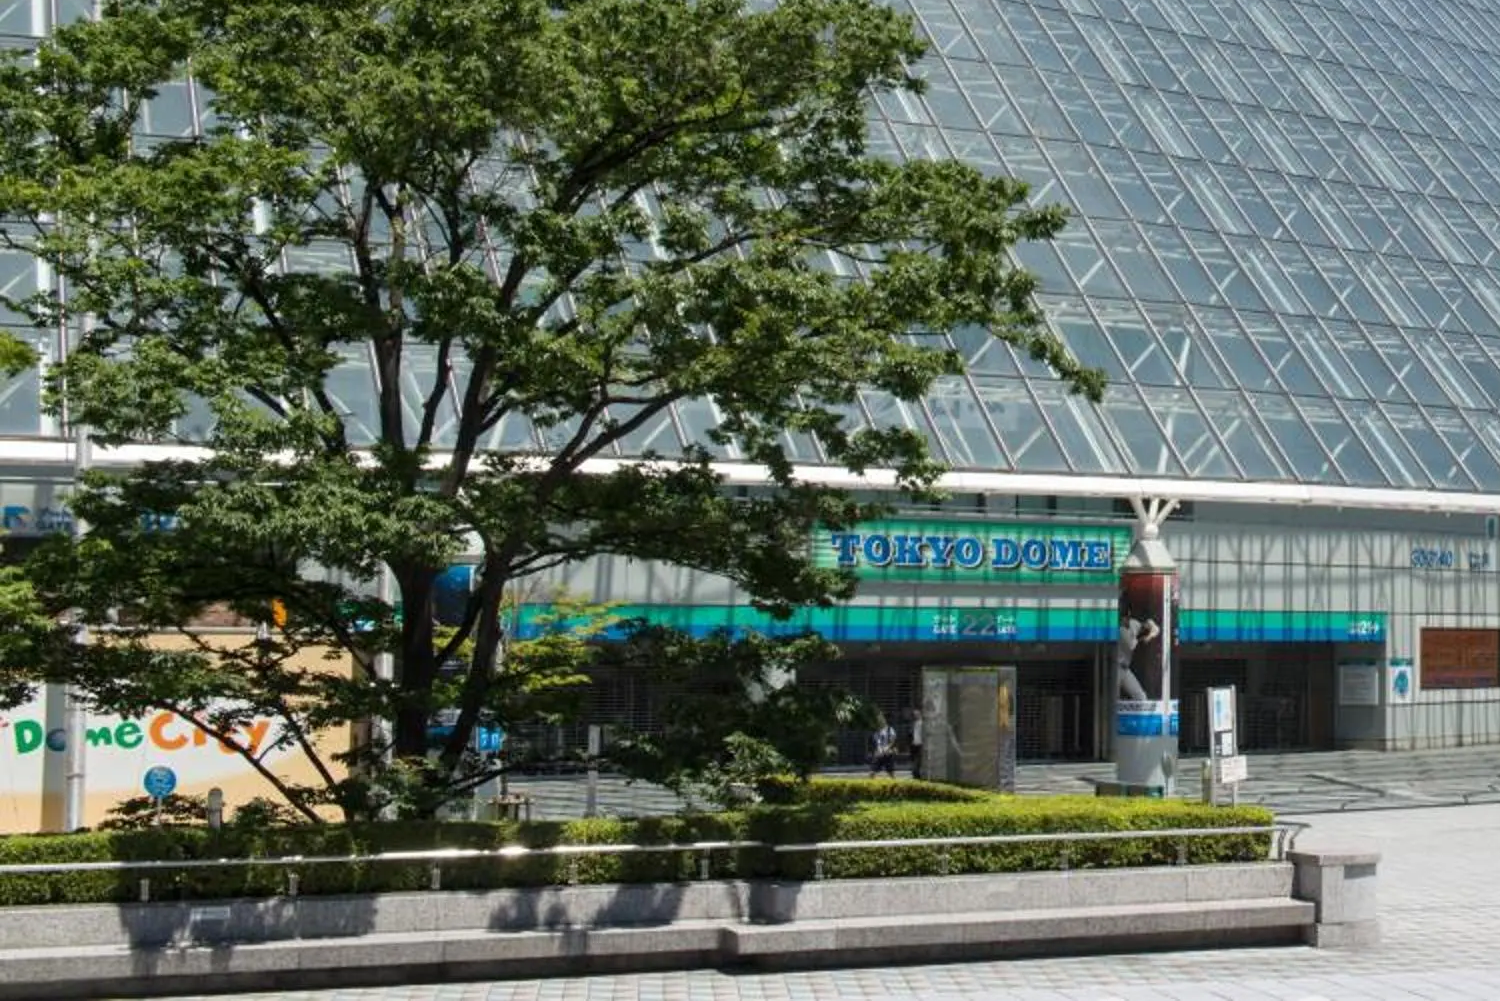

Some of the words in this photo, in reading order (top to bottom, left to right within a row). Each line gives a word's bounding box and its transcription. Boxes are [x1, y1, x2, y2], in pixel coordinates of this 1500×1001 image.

[831, 533, 982, 567] TOKYO
[991, 537, 1111, 569] DOME
[13, 718, 143, 755] Dome
